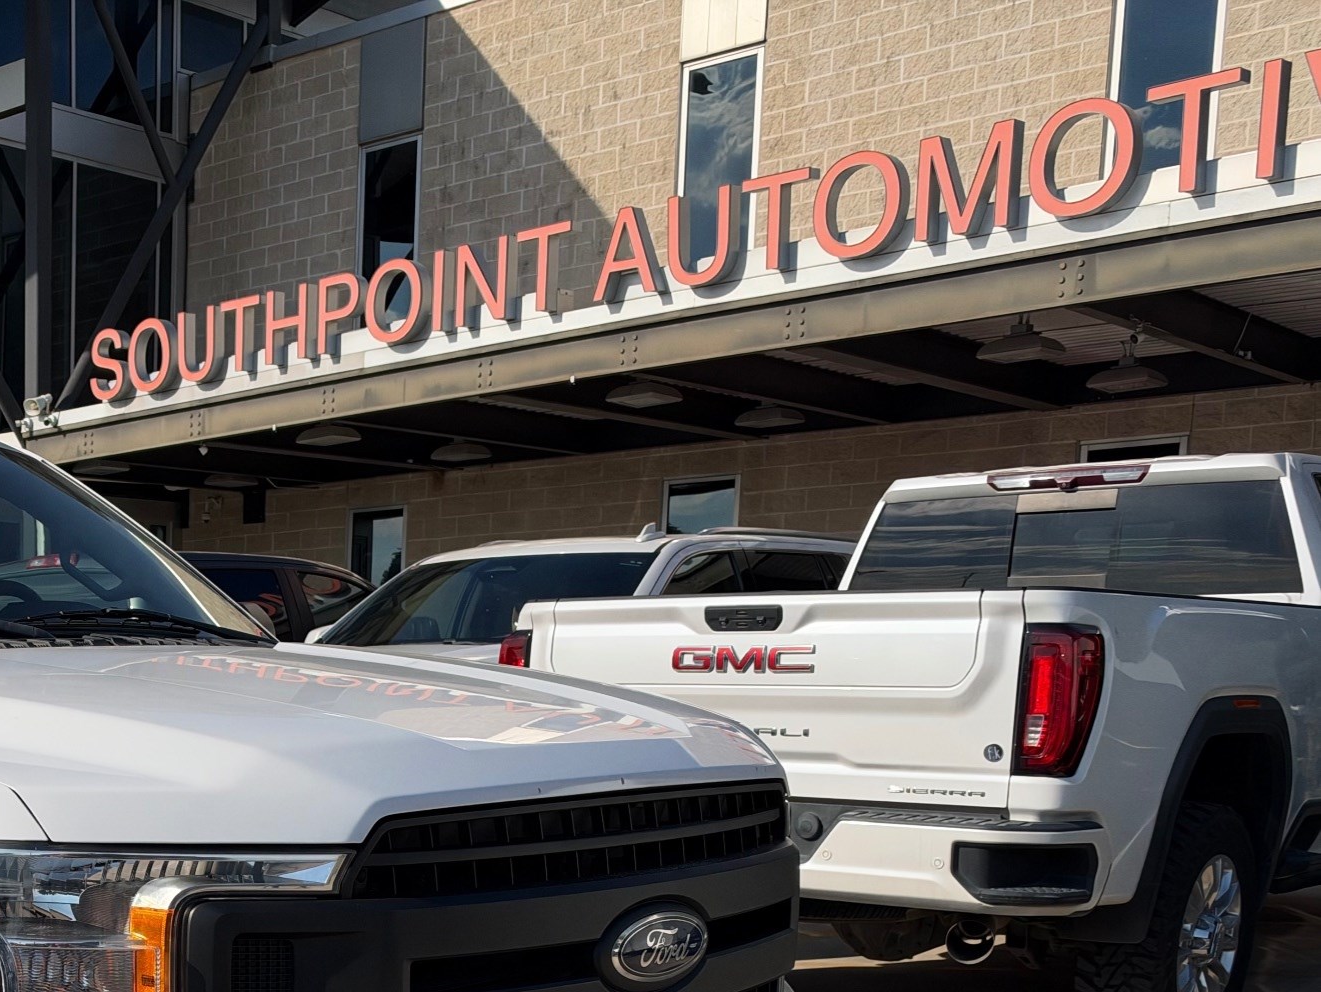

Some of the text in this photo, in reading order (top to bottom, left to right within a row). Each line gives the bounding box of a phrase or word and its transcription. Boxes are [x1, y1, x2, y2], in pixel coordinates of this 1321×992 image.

[91, 49, 1321, 402] SOUTHPOINT AUTOMOTI
[672, 645, 816, 673] GMC
[753, 727, 810, 738] ALI
[640, 927, 696, 968] Ford
